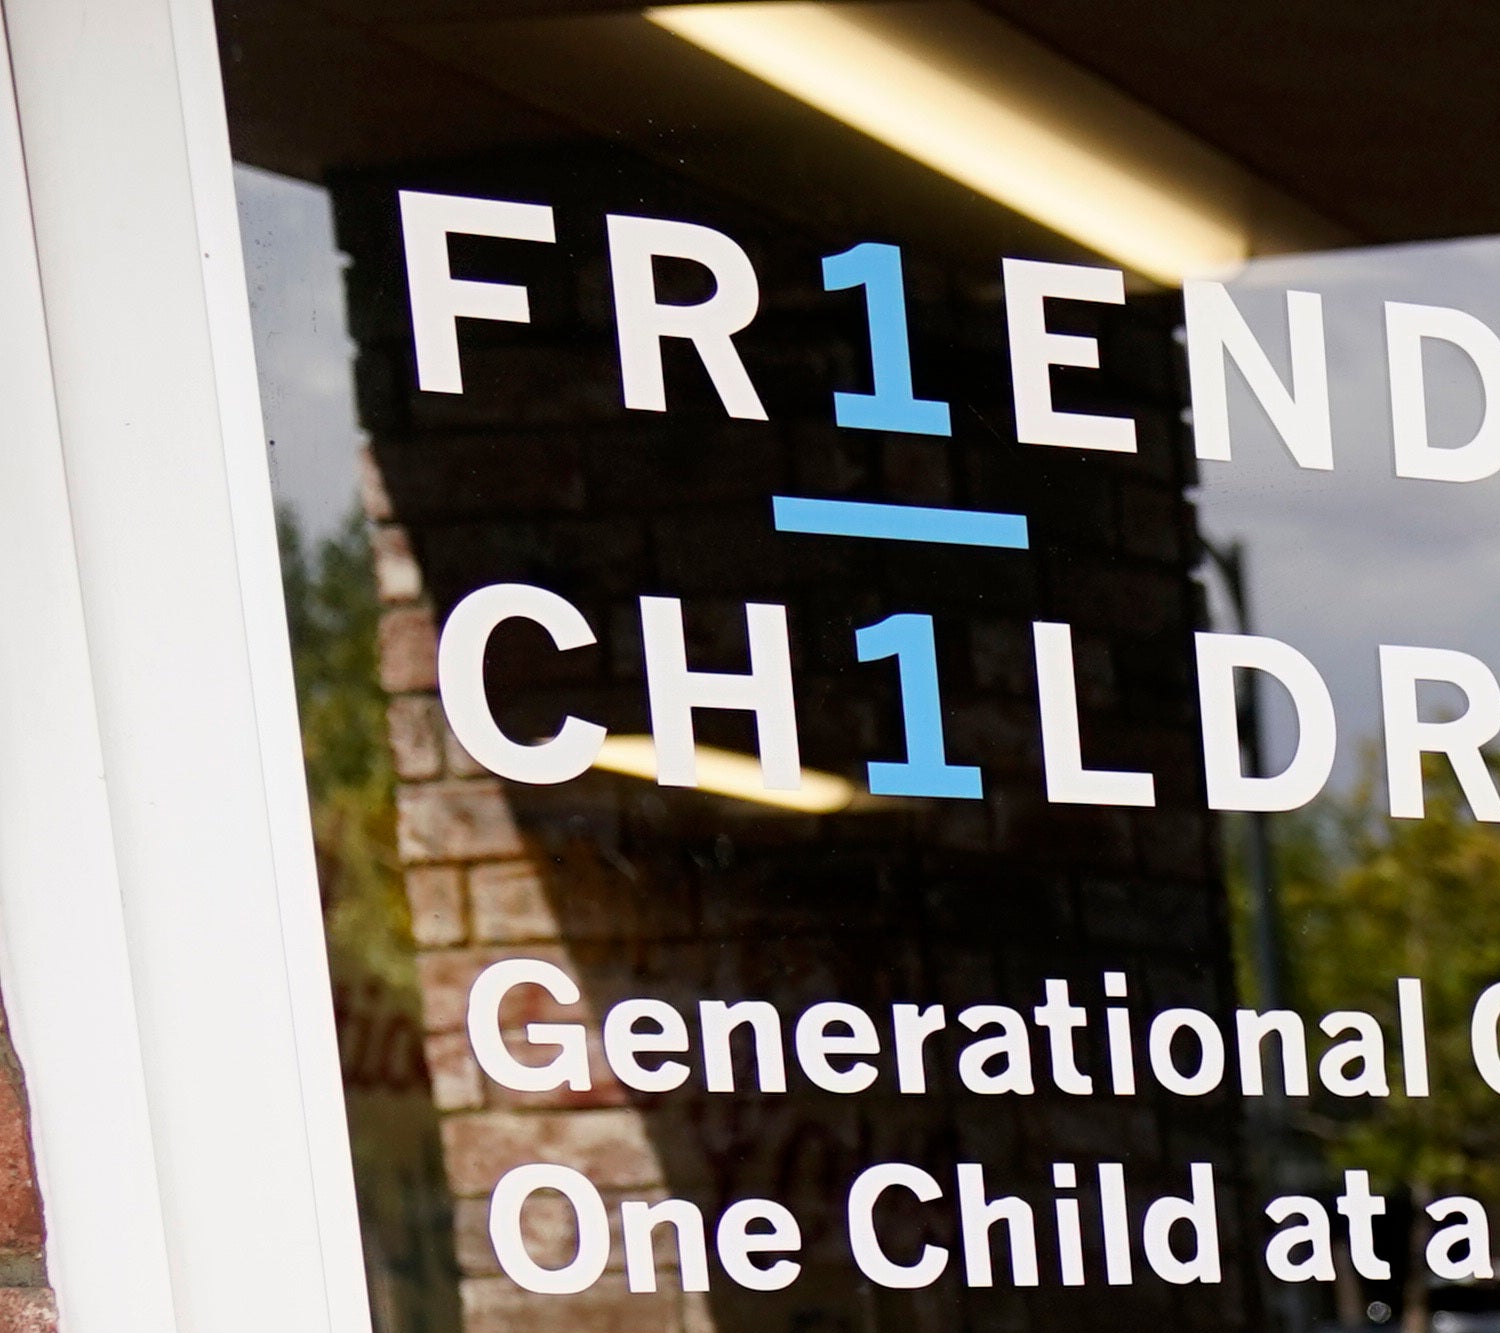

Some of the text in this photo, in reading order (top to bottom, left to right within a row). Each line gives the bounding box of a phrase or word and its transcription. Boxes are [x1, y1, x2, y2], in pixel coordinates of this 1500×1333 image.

[466, 958, 1431, 1098] Generational
[488, 1162, 802, 1294] One
[847, 1162, 1222, 1289] Child
[1264, 1170, 1392, 1282] at
[1424, 1193, 1495, 1282] a
